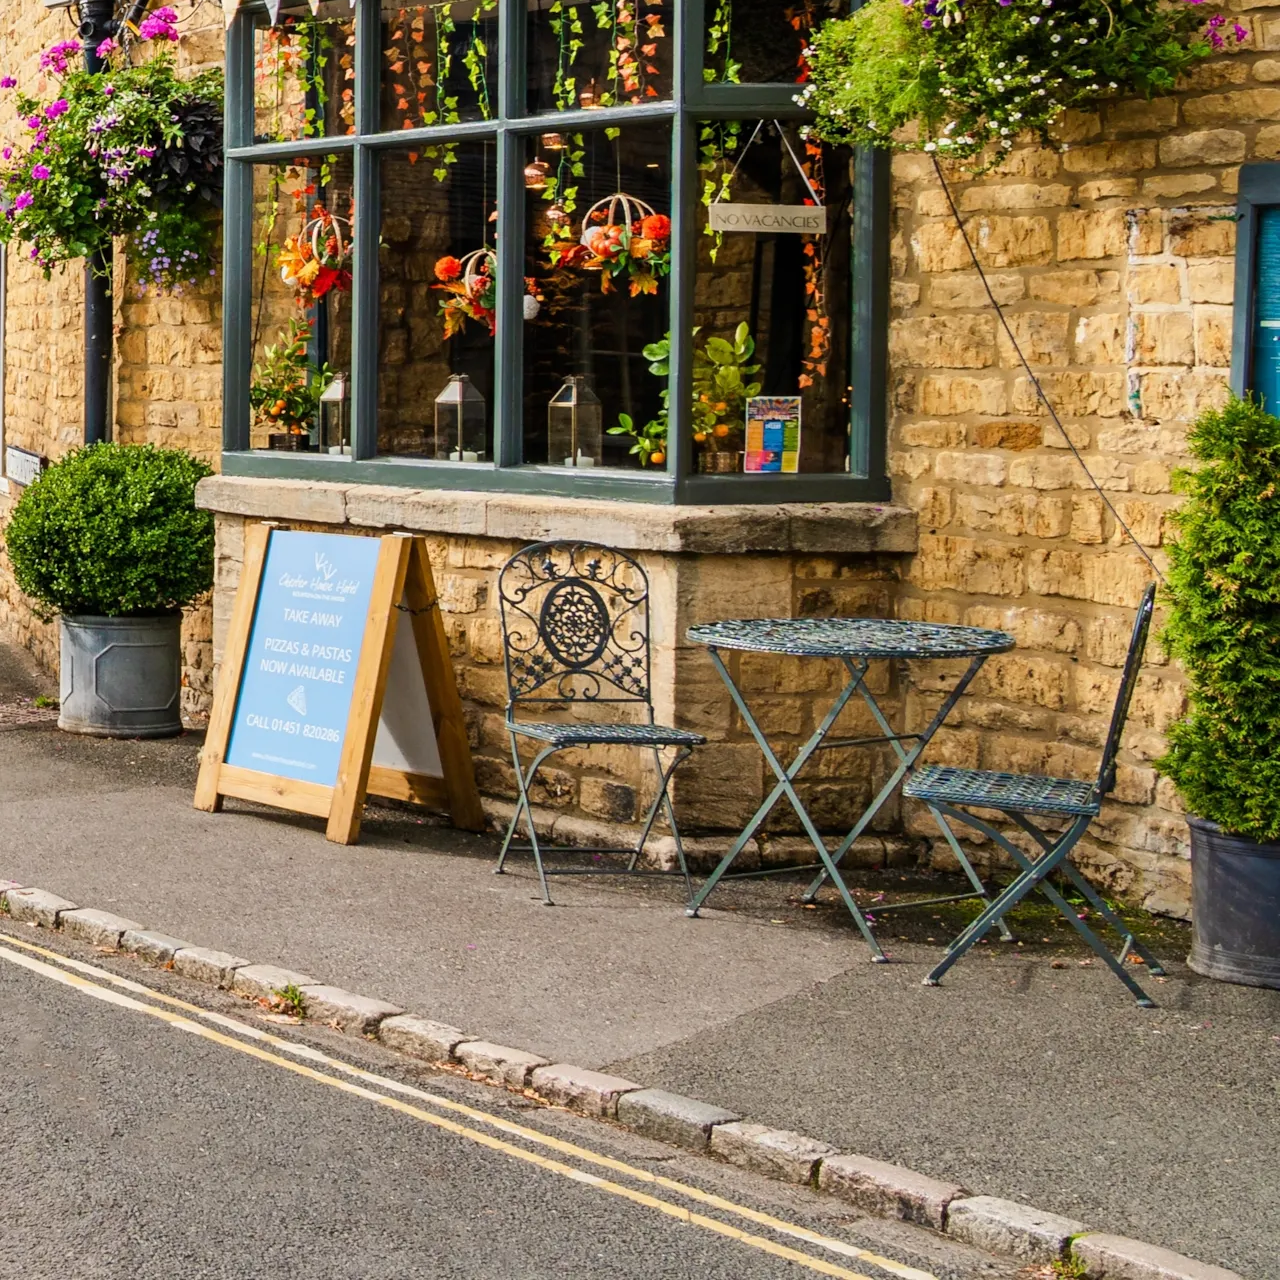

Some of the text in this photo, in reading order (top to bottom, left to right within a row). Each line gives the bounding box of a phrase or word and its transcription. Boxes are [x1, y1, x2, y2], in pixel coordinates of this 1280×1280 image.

[715, 213, 820, 229] NO VACANCIES
[283, 608, 343, 628] TAKE AWAY
[264, 637, 352, 662] PIZZAS & PASTAS
[260, 659, 346, 684] NOW AVAILABLE
[246, 714, 340, 743] CALL 01451 820286
